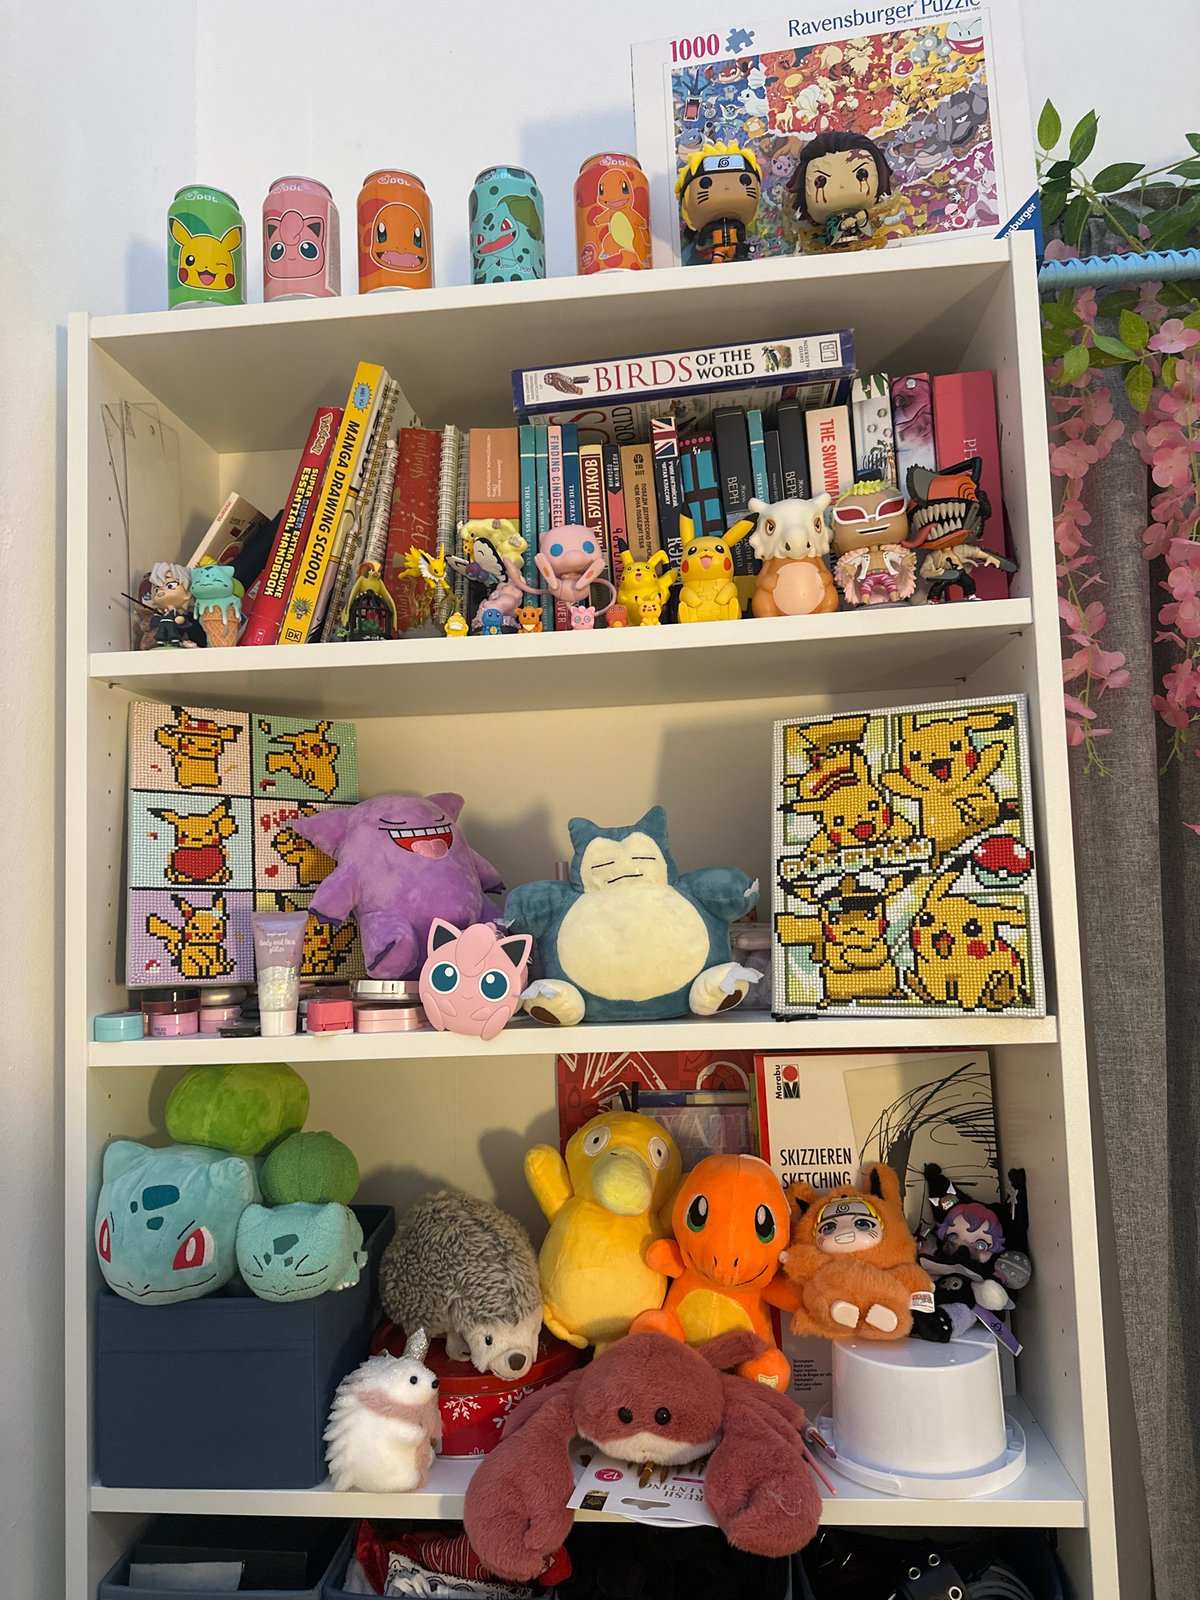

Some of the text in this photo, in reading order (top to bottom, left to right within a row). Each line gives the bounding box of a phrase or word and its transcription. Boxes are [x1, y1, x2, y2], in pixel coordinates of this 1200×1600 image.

[788, 3, 914, 38] Ravensburger
[670, 34, 720, 62] 1000
[1003, 202, 1037, 239] nsburger
[695, 348, 752, 366] OF THE
[696, 362, 755, 380] WORLD
[593, 356, 693, 393] BIRDS
[611, 406, 636, 442] ORLD
[819, 418, 836, 443] THE
[550, 435, 560, 473] FINDING
[585, 459, 602, 519] БУЛГАКОВ
[633, 483, 641, 496] ЧЕМ
[640, 483, 649, 506] ПОБЕДИ
[726, 476, 740, 505] ВЕРН
[785, 471, 798, 499] ВЕРН
[303, 420, 361, 586] MANGA DRAWING SCHOOL
[635, 496, 643, 509] ОНА
[264, 467, 311, 597] ESSENTIAL HANDBOOK
[273, 468, 319, 599] SUPER DUPER EXTRA DELUXE
[636, 509, 644, 534] ПОБЕДИТ
[642, 506, 652, 541] ДЕПРЕССИЮ
[557, 600, 567, 623] OVER
[288, 631, 300, 640] DK
[773, 1064, 783, 1100] Marabu
[780, 1147, 852, 1166] SKIZZIEREN
[781, 1171, 852, 1189] SKETCHING
[603, 1471, 619, 1480] 12
[664, 1490, 704, 1502] RUSH
